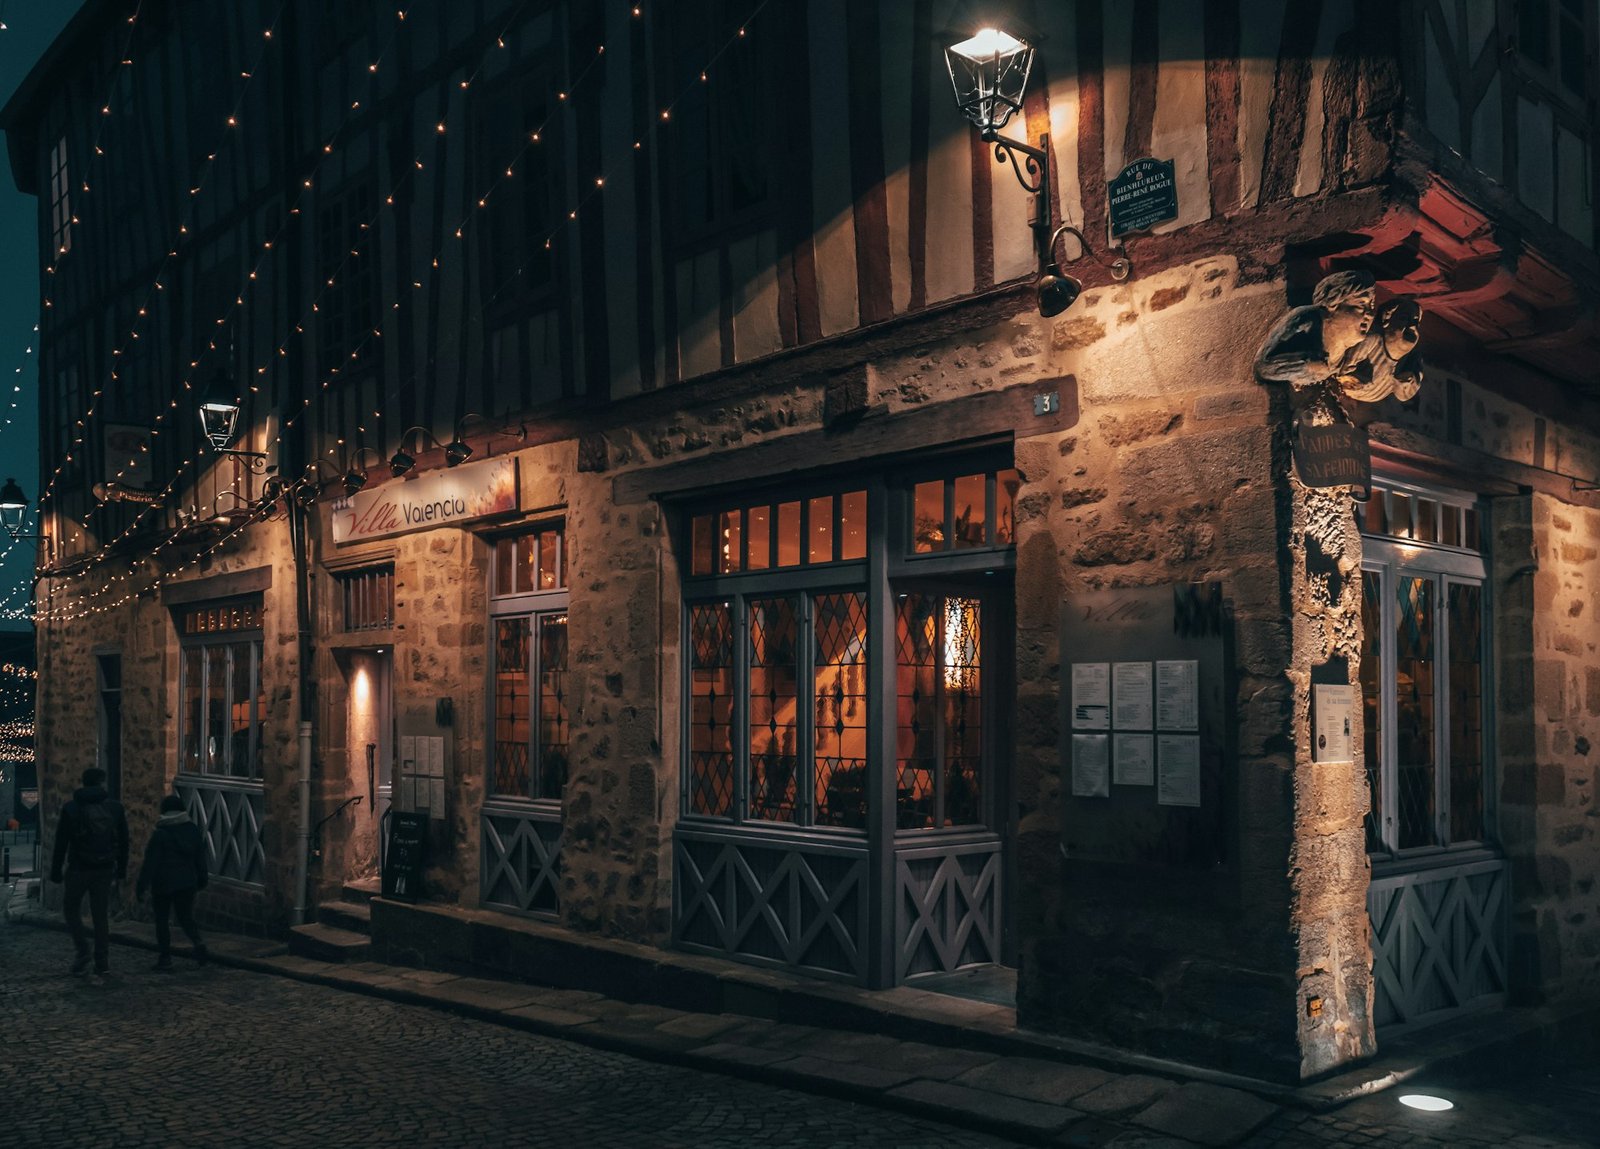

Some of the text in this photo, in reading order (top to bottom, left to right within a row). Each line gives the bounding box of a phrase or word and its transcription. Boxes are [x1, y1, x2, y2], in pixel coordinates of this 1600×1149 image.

[1126, 162, 1154, 177] RUE DU
[1116, 172, 1165, 195] BIENHEUREUX
[1149, 179, 1171, 192] ROGUE
[1043, 395, 1050, 412] 3
[344, 492, 402, 536] Villa
